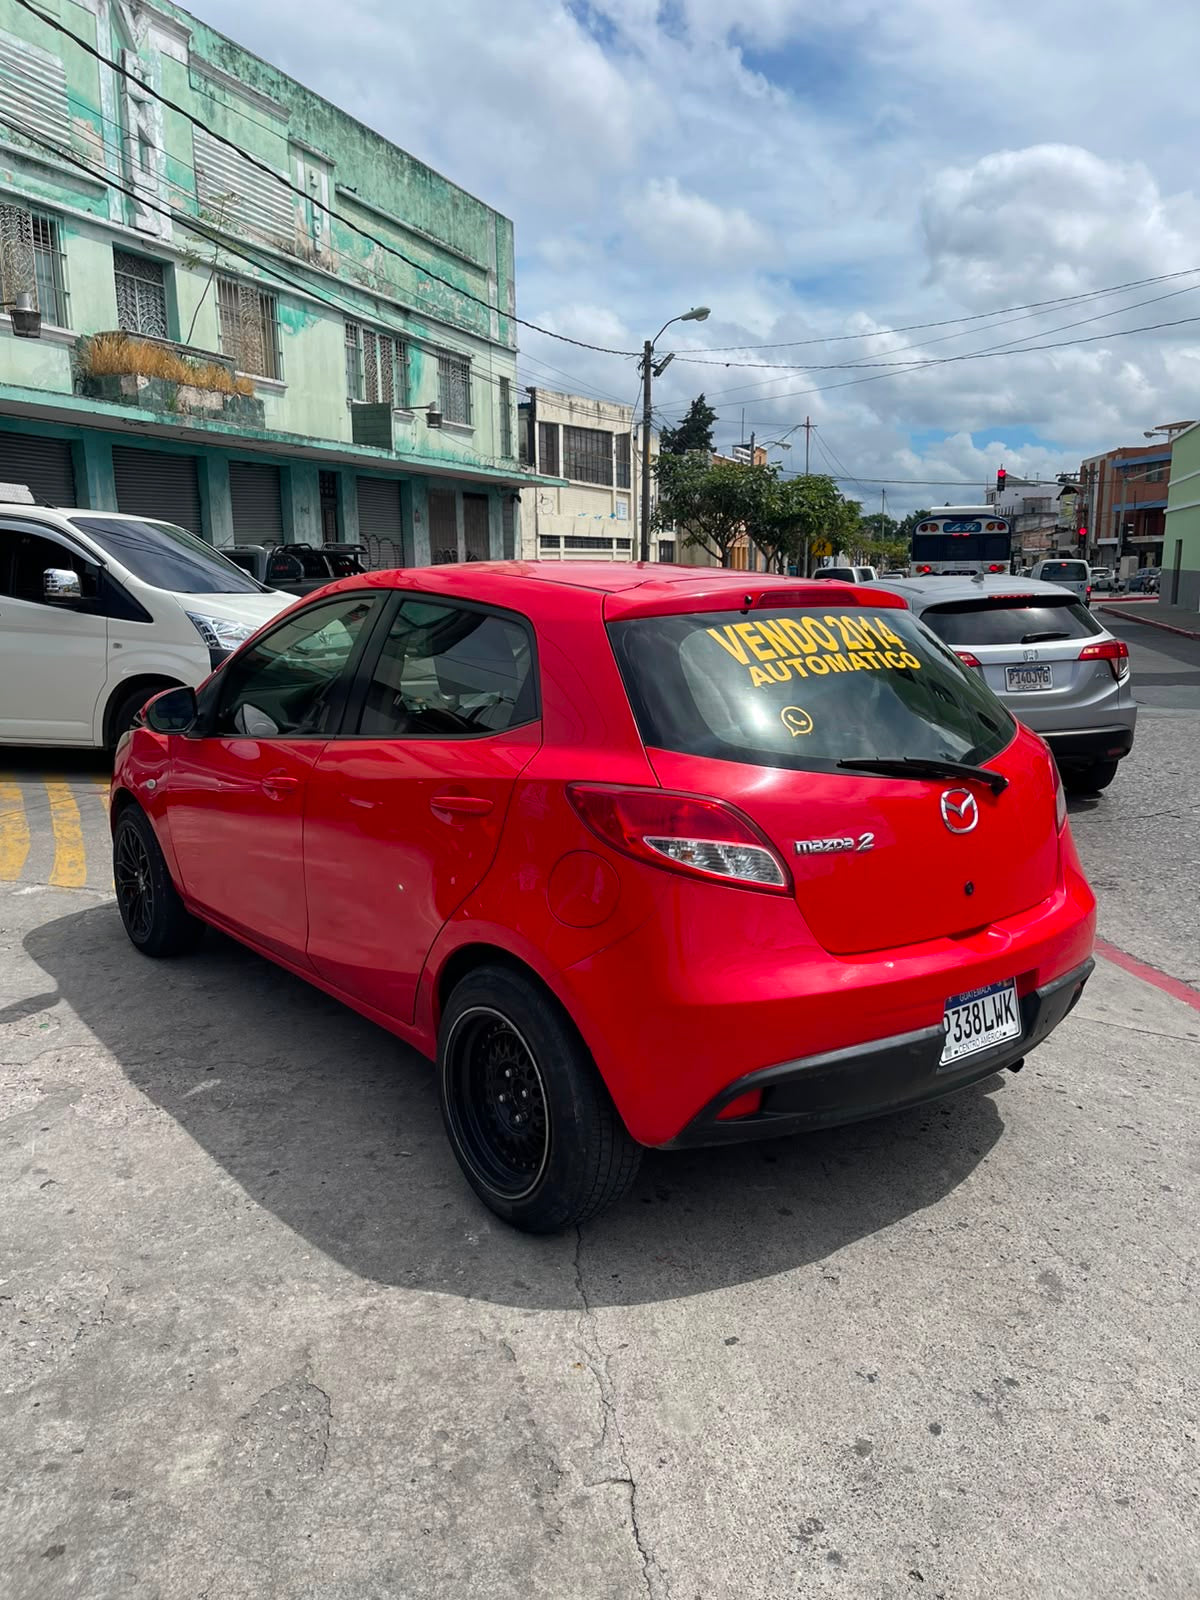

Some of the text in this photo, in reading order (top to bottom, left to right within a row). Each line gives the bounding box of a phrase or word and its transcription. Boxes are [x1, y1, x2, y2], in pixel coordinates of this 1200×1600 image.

[706, 615, 907, 666] VENDO 2014
[748, 651, 922, 687] AUTOMATICO
[855, 832, 875, 851] 2
[959, 985, 992, 1002] GUATEMALA
